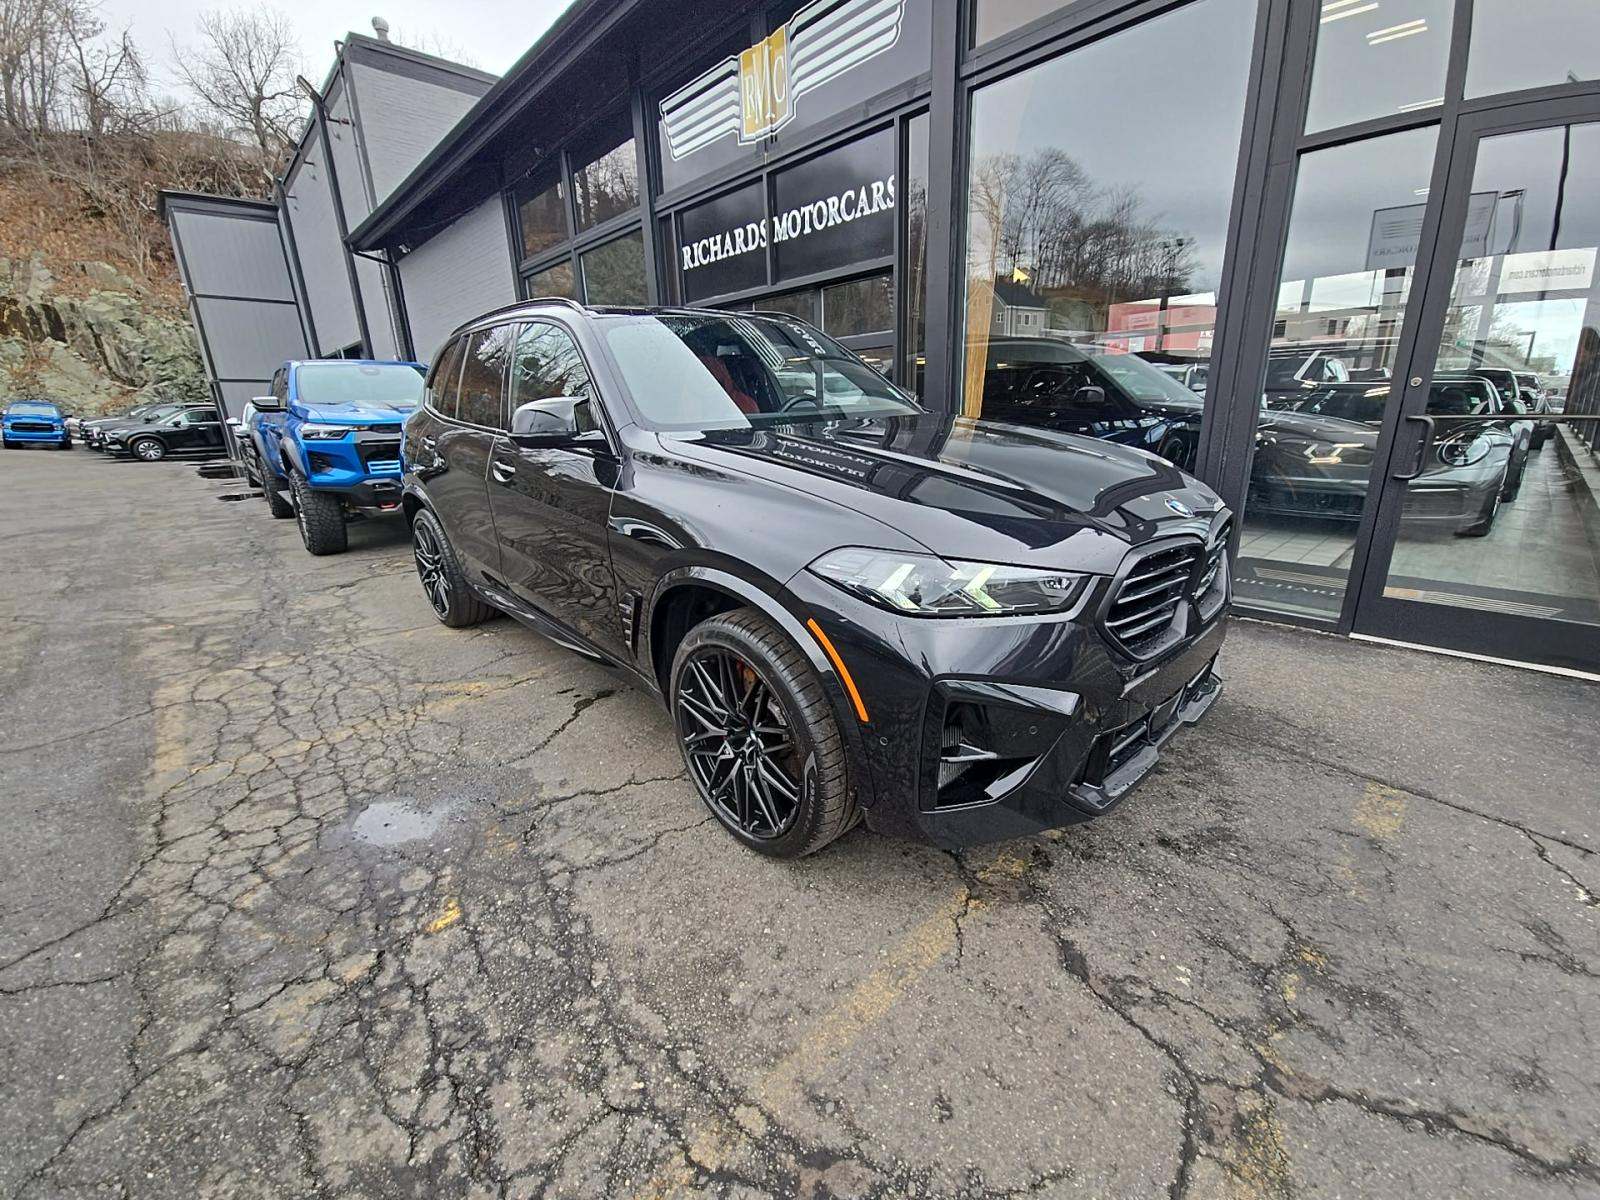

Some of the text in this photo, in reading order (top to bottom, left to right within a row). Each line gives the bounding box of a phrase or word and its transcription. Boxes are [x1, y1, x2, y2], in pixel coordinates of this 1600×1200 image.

[745, 44, 787, 123] RMC
[682, 175, 894, 270] RICHARDS MOTORCARS
